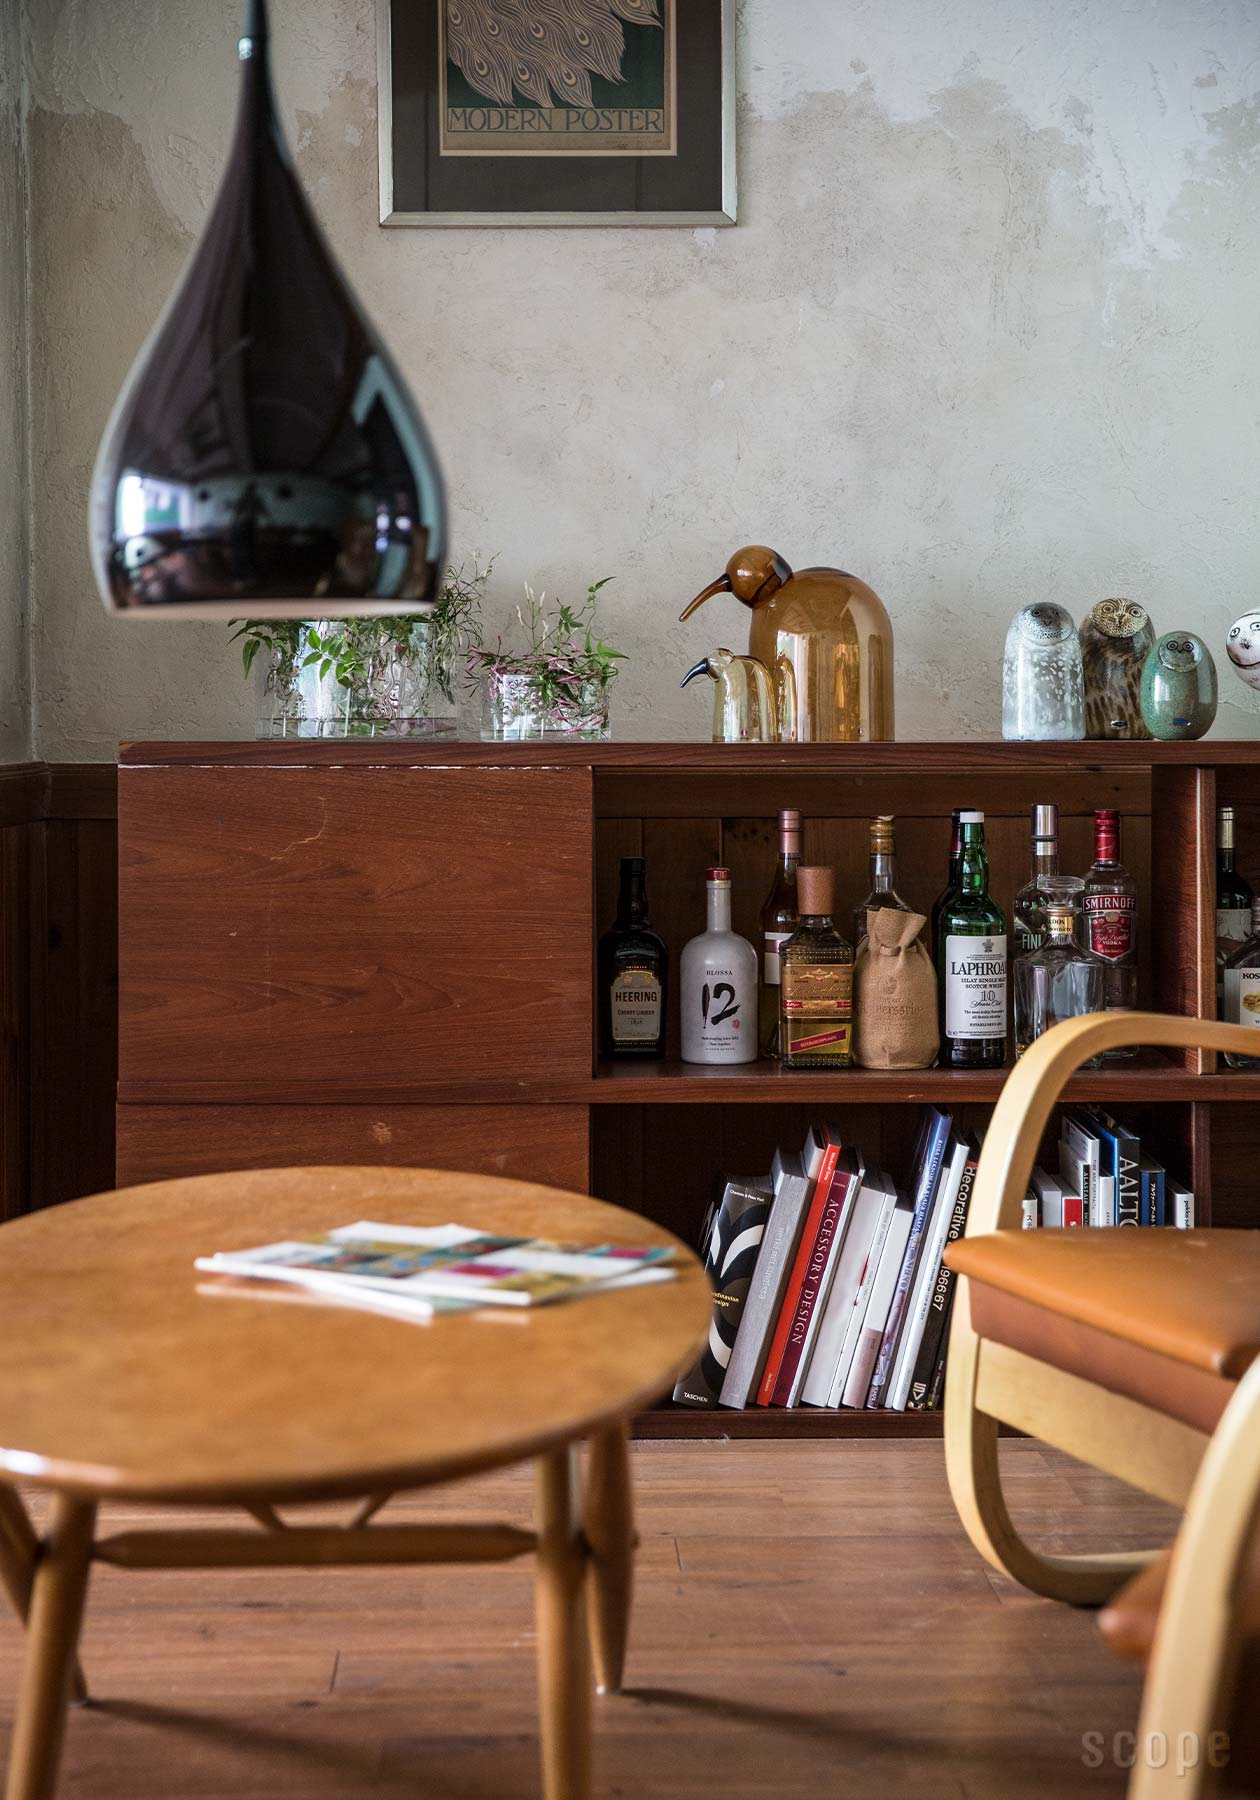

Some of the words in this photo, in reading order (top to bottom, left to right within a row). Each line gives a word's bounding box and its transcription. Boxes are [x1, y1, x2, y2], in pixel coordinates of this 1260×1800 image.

[450, 108, 552, 131] MODERN
[565, 108, 662, 131] POSTER
[1085, 897, 1135, 909] SMIRNOFF
[615, 991, 657, 1002] HEERING
[702, 982, 741, 1030] 12
[980, 990, 996, 1002] 10
[949, 1165, 976, 1239] decorative
[808, 1199, 839, 1284] ACCESSORY
[791, 1290, 815, 1344] DESIGN
[683, 1392, 708, 1403] TASCHEN
